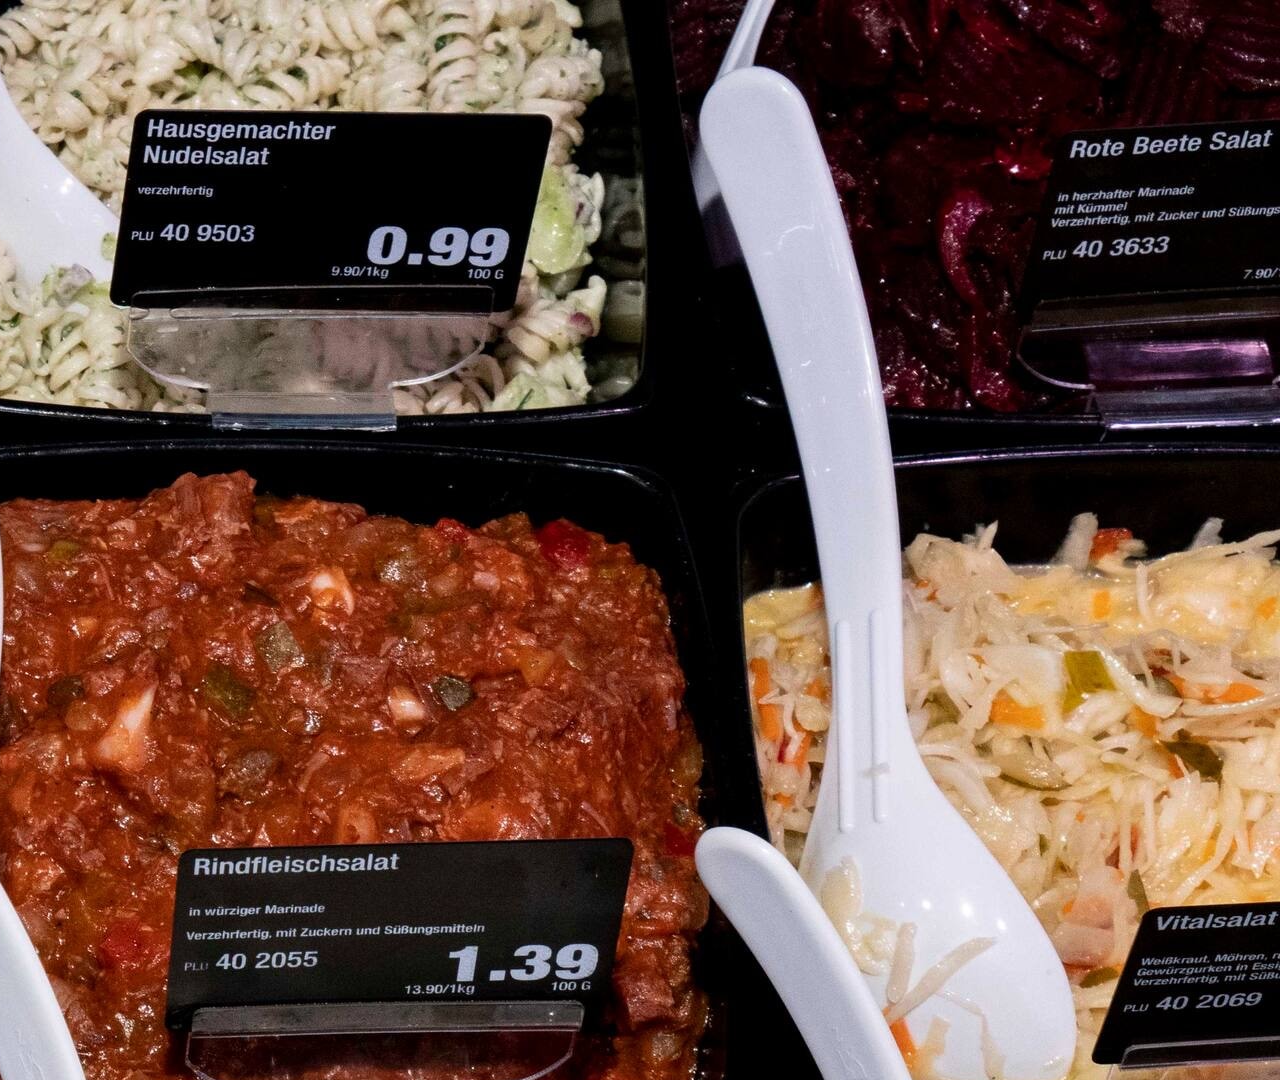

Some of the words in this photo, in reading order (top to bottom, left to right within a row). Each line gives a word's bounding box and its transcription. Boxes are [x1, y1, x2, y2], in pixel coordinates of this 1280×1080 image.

[147, 118, 337, 143] Hausgemachter
[1069, 138, 1125, 159] Rote
[1132, 134, 1202, 155] Beete
[1209, 129, 1273, 151] Salat
[143, 144, 270, 166] Nudelsalat
[137, 185, 214, 198] verzehrfertig
[1057, 192, 1070, 202] in
[1071, 188, 1136, 202] herzhafter
[1137, 184, 1195, 198] Marinade
[1051, 214, 1131, 228] Verzehrfertig,
[1134, 211, 1155, 223] mit
[1156, 210, 1200, 222] Zucker
[1201, 207, 1226, 219] und
[1054, 204, 1075, 215] mit
[1076, 201, 1128, 215] Kümmel
[131, 230, 155, 242] PLU
[159, 223, 190, 242] 40
[196, 224, 256, 243] 9503
[366, 225, 510, 268] 0.99
[1042, 249, 1067, 261] PLU
[1072, 239, 1104, 258] 40
[1109, 235, 1171, 257] 3633
[331, 265, 390, 280] 9.90/1kg
[467, 268, 492, 280] 100
[494, 269, 504, 280] G
[193, 853, 400, 876] Rindfleischsalat
[188, 907, 201, 917] in
[204, 905, 262, 918] würziger
[264, 903, 326, 915] Marinade
[1156, 910, 1279, 931] Vitalsalat
[186, 928, 273, 941] Verzehrfertig,
[275, 927, 297, 938] mit
[300, 927, 353, 937] Zuckern
[355, 926, 381, 936] und
[383, 923, 486, 936] Süßungsmitteln
[215, 953, 247, 970] 40
[254, 950, 319, 969] 2055
[448, 943, 599, 985] 1.39
[1136, 964, 1233, 977] Gewürzgurken
[404, 983, 475, 996] 13.90/1kg
[551, 981, 577, 991] 100
[580, 980, 591, 991] G
[1123, 1003, 1150, 1013] PLU
[1155, 995, 1189, 1011] 40
[1195, 991, 1263, 1009] 2069
